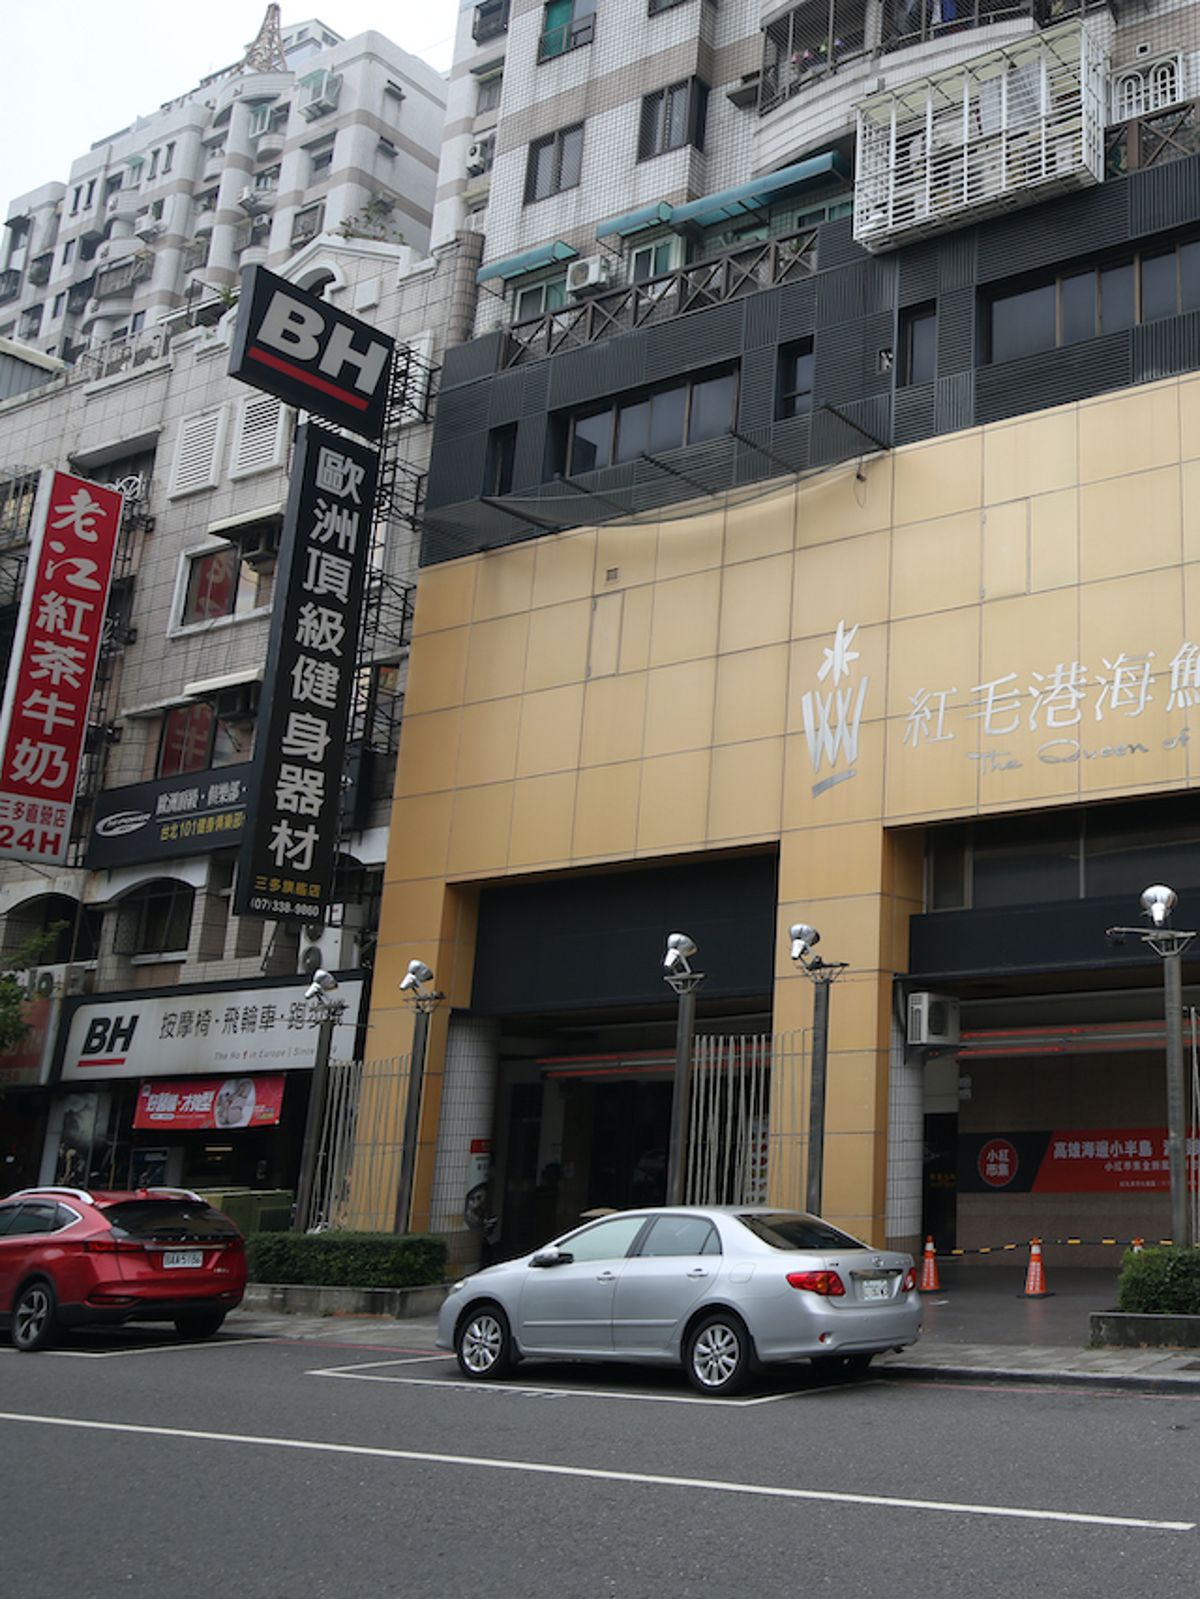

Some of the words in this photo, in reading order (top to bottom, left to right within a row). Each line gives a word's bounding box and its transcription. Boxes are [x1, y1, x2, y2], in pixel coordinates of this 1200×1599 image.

[256, 290, 391, 396] BH
[10, 488, 107, 790] 老江紅茶牛奶
[268, 446, 367, 872] 歐洲頂級健身器材
[0, 825, 61, 856] 24H
[81, 1015, 140, 1056] BH
[986, 1149, 1009, 1162] 小紅
